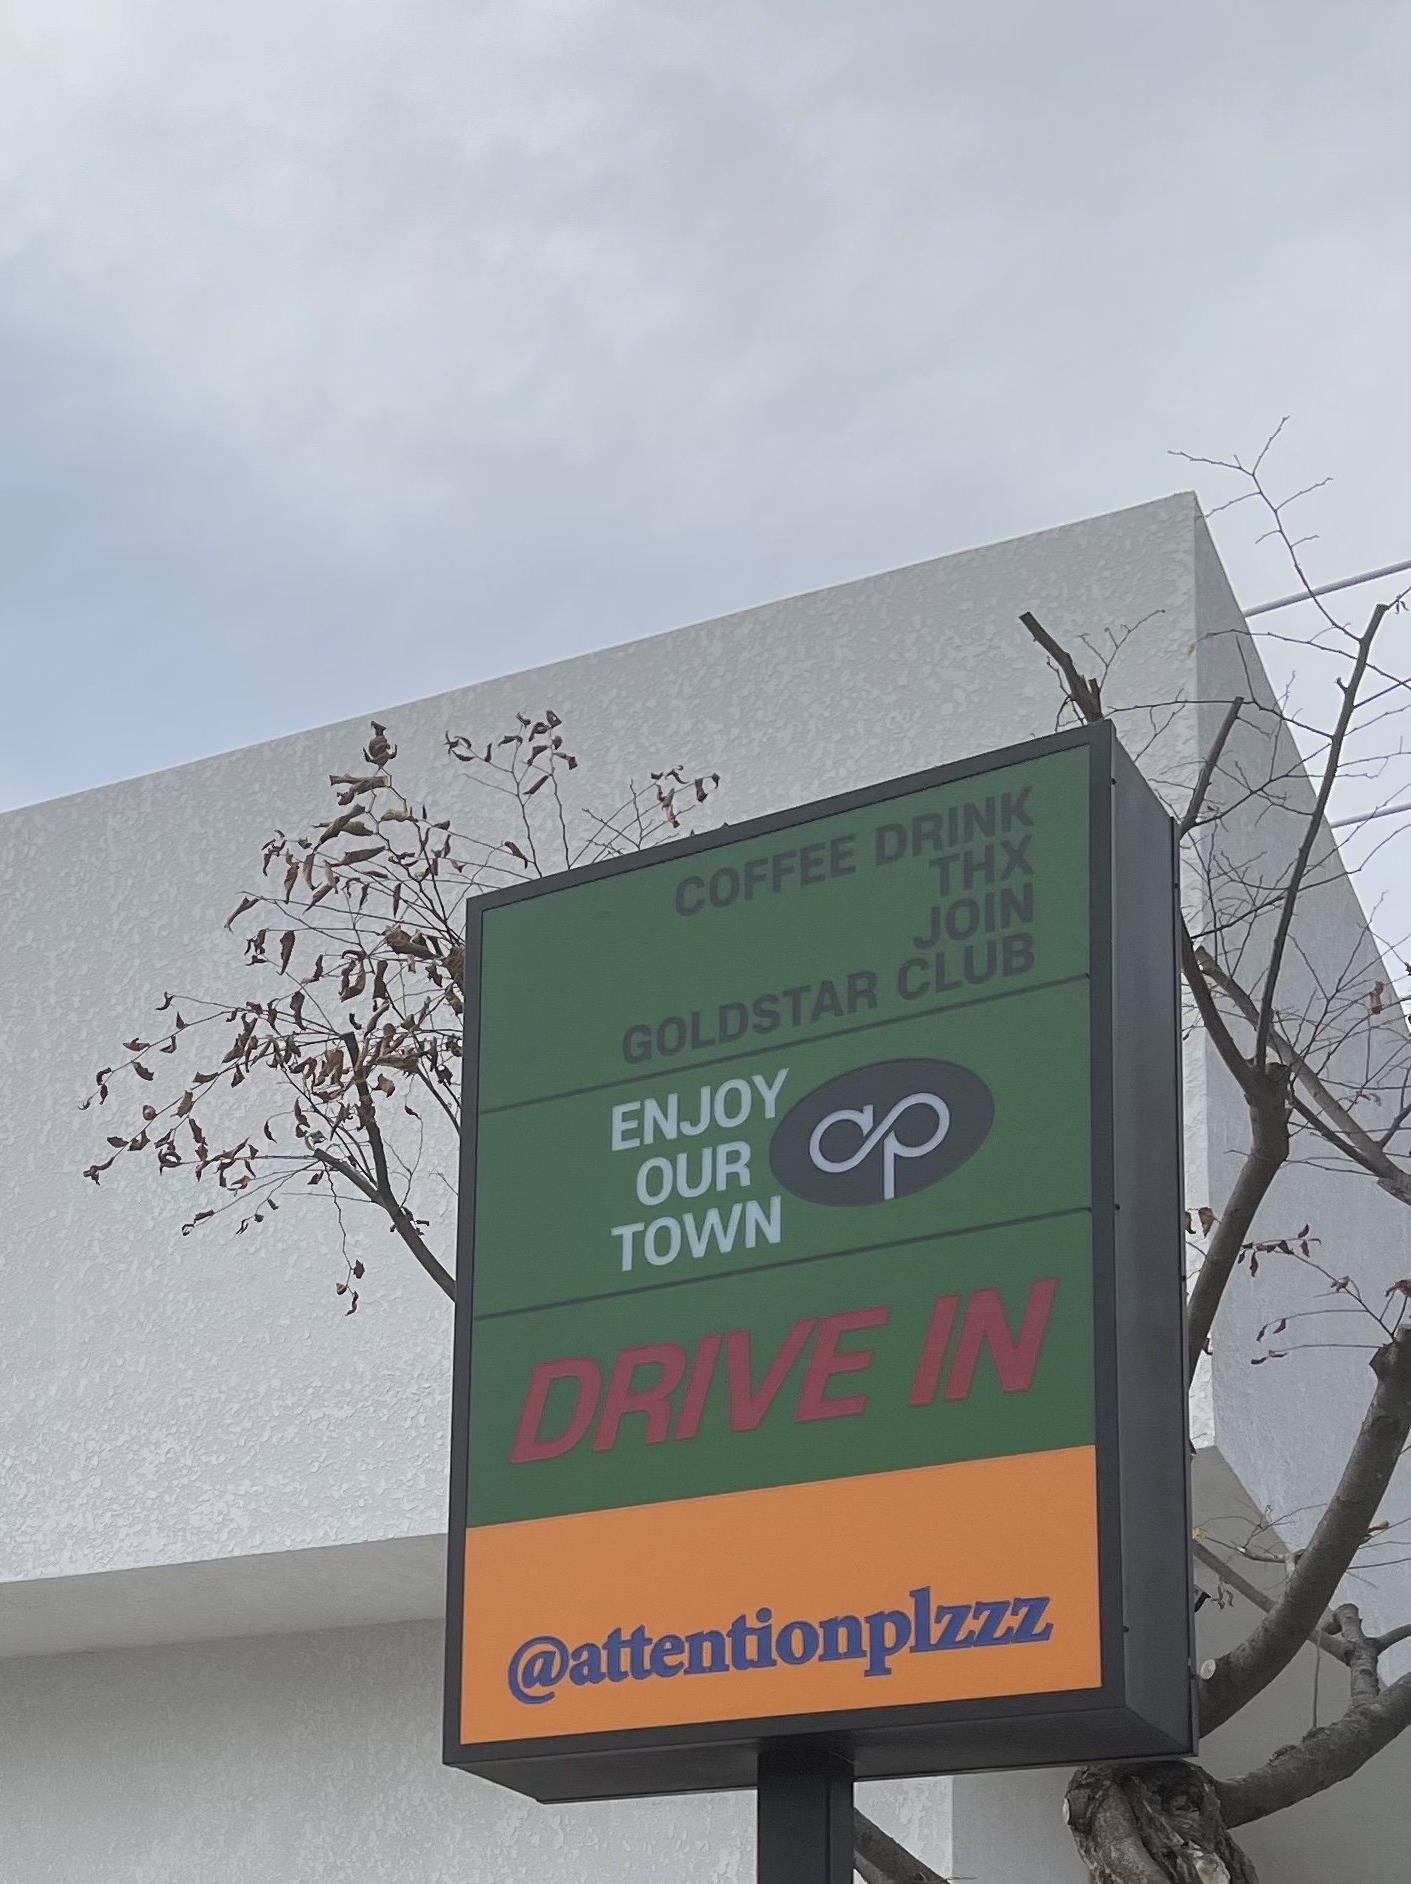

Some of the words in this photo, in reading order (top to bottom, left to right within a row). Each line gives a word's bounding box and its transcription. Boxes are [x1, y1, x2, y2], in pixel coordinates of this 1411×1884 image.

[674, 834, 857, 917] COFFEE
[875, 785, 1035, 866] DRINK
[929, 834, 1034, 897] THX
[913, 882, 1035, 950] JOIN
[622, 971, 878, 1065] GOLDSTAR
[898, 932, 1035, 1001] CLUB
[610, 1068, 790, 1151] ENJOY
[636, 1140, 751, 1206] OUR
[611, 1195, 782, 1271] TOWN
[509, 1306, 888, 1464] DRIVE
[908, 1278, 1058, 1406] IN
[508, 1586, 1054, 1705] @attentionplzzz
